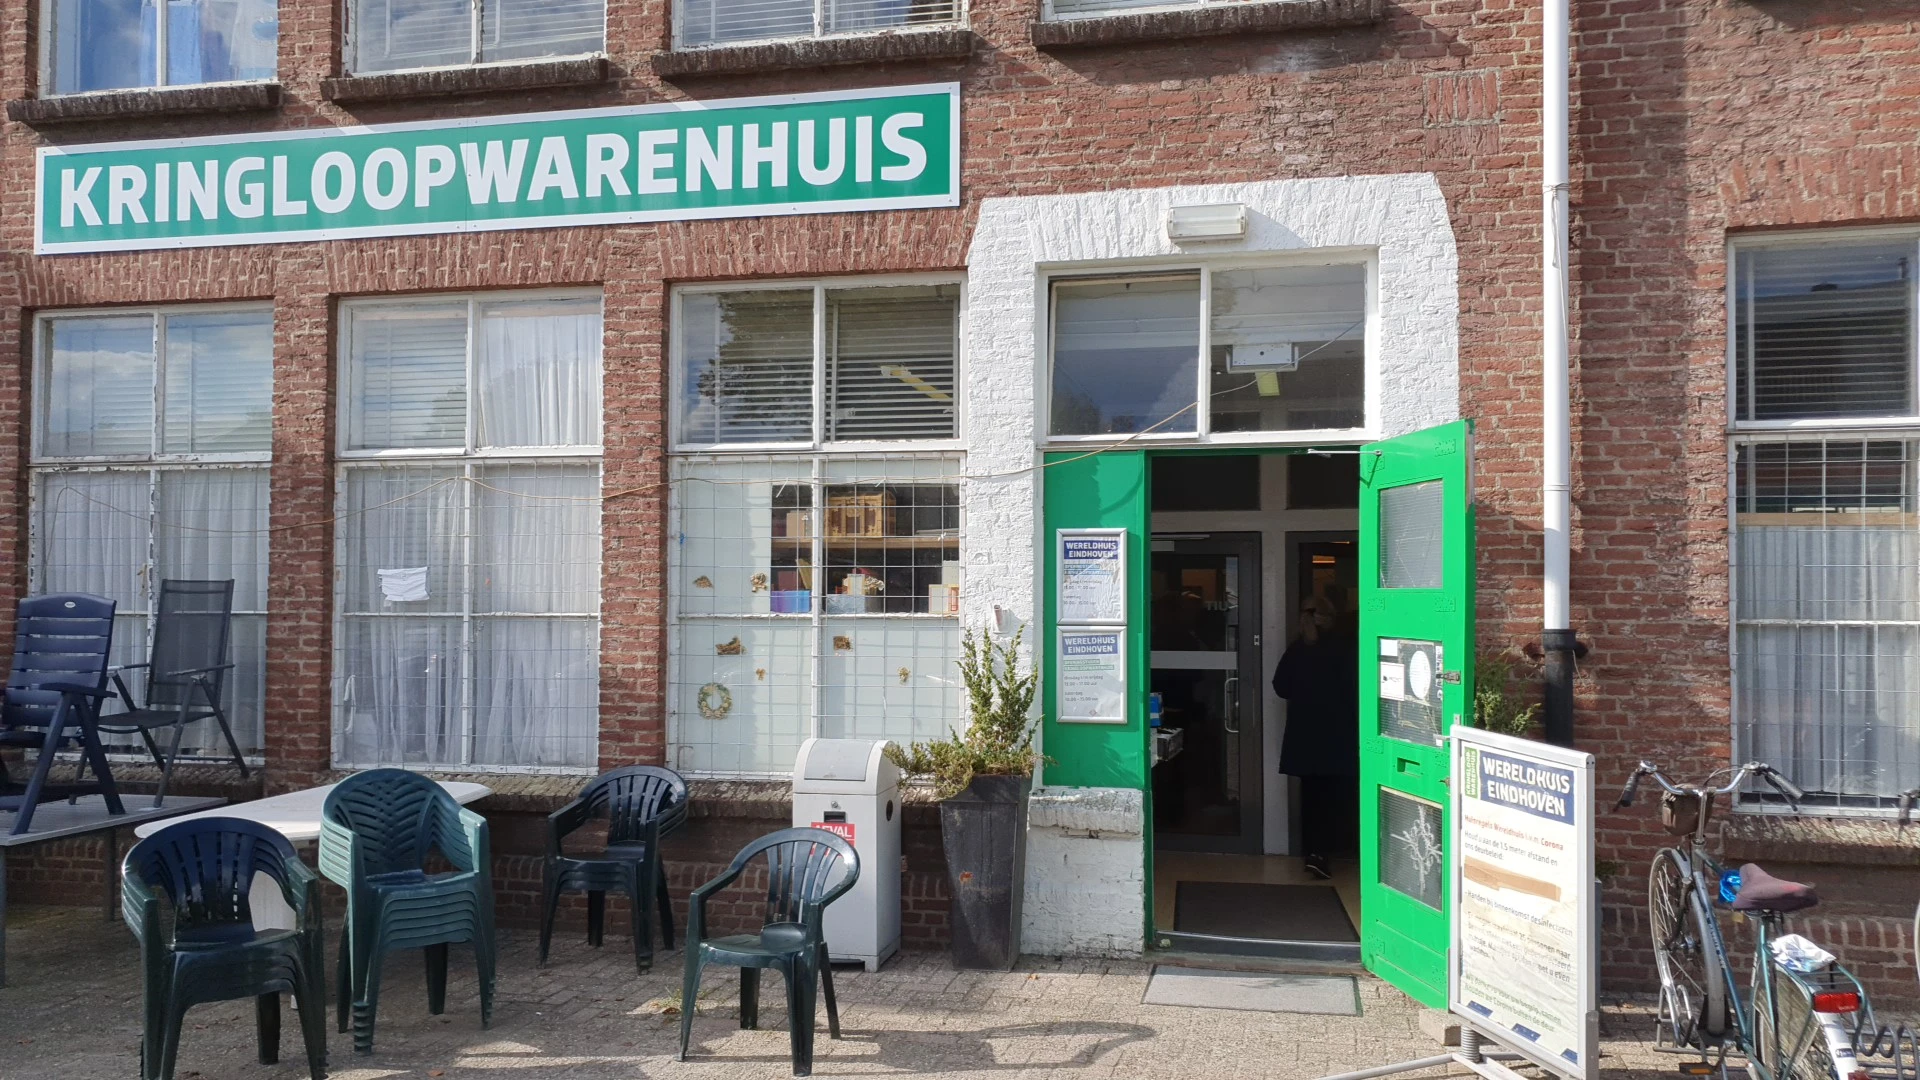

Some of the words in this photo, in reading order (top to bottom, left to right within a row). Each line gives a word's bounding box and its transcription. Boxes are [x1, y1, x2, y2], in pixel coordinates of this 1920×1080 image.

[60, 112, 929, 228] KRINGLOOPWARENHUIS
[1065, 637, 1115, 645] WERELDHUIS
[1482, 756, 1570, 794] WERELDHUIS
[1487, 780, 1566, 817] EINDHOVEN
[1494, 824, 1524, 839] Wereldhuis
[1541, 838, 1564, 850] Corona
[1528, 851, 1550, 864] afstand
